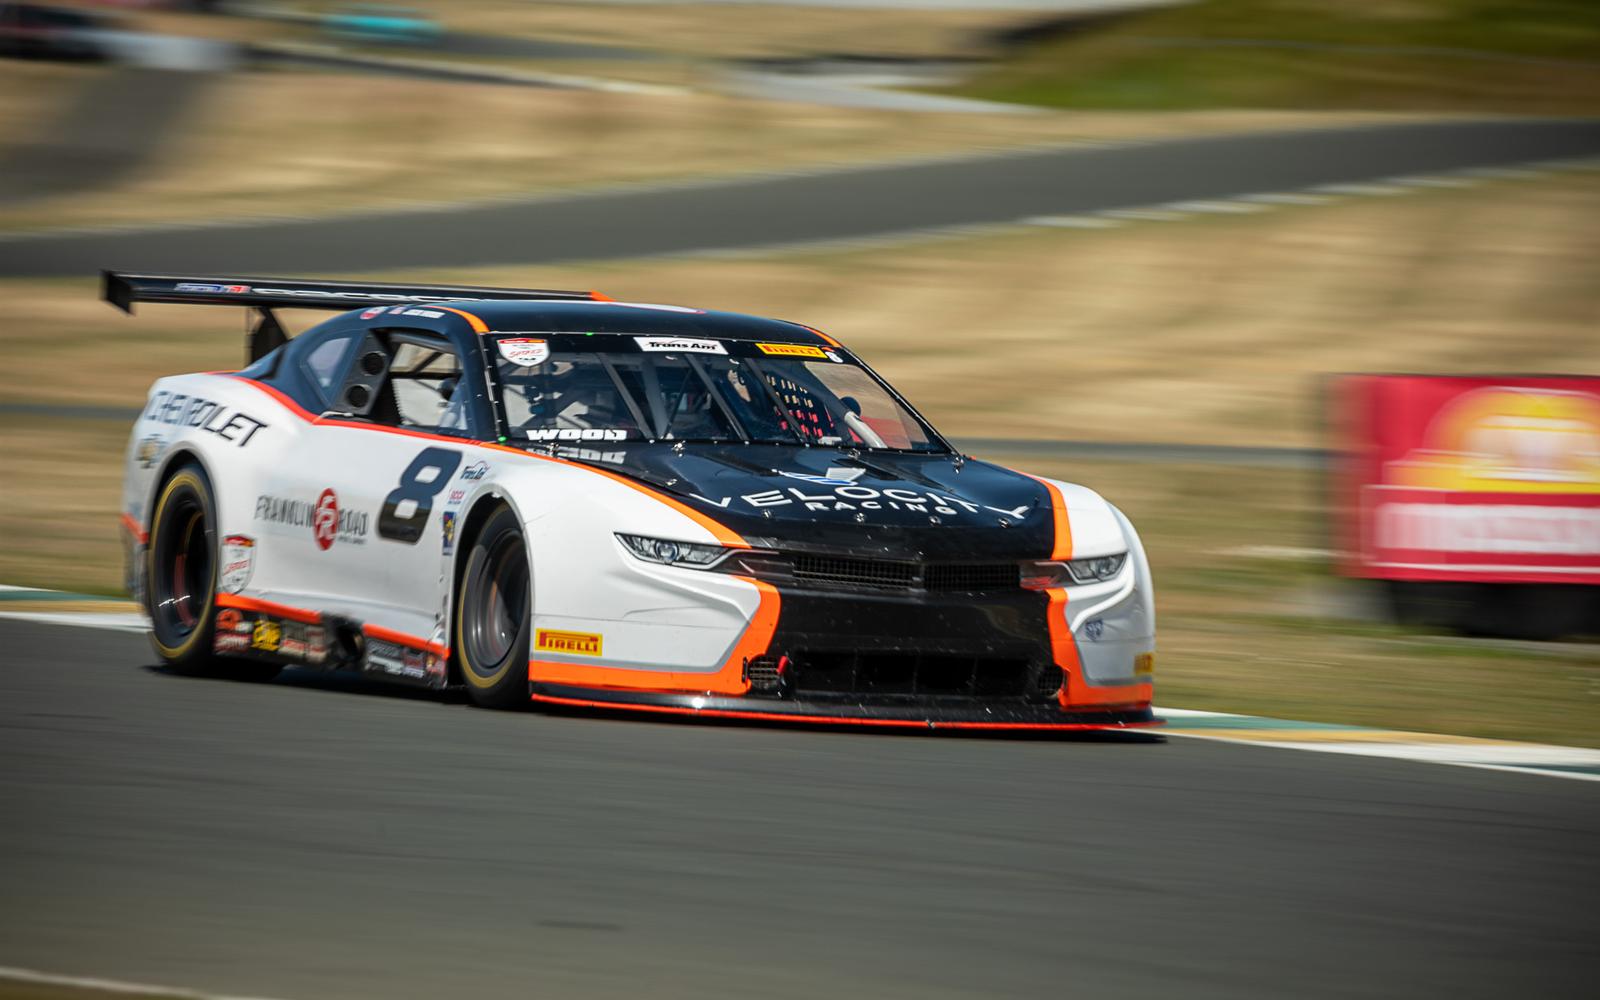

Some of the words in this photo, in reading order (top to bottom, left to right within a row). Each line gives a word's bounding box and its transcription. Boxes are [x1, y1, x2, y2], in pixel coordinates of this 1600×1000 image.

[762, 345, 821, 356] PIRELLI
[526, 429, 627, 441] WOOD
[376, 446, 462, 545] 8
[689, 486, 1029, 520] VELOCITY
[805, 501, 958, 516] RACING
[539, 632, 598, 652] PIRELLI
